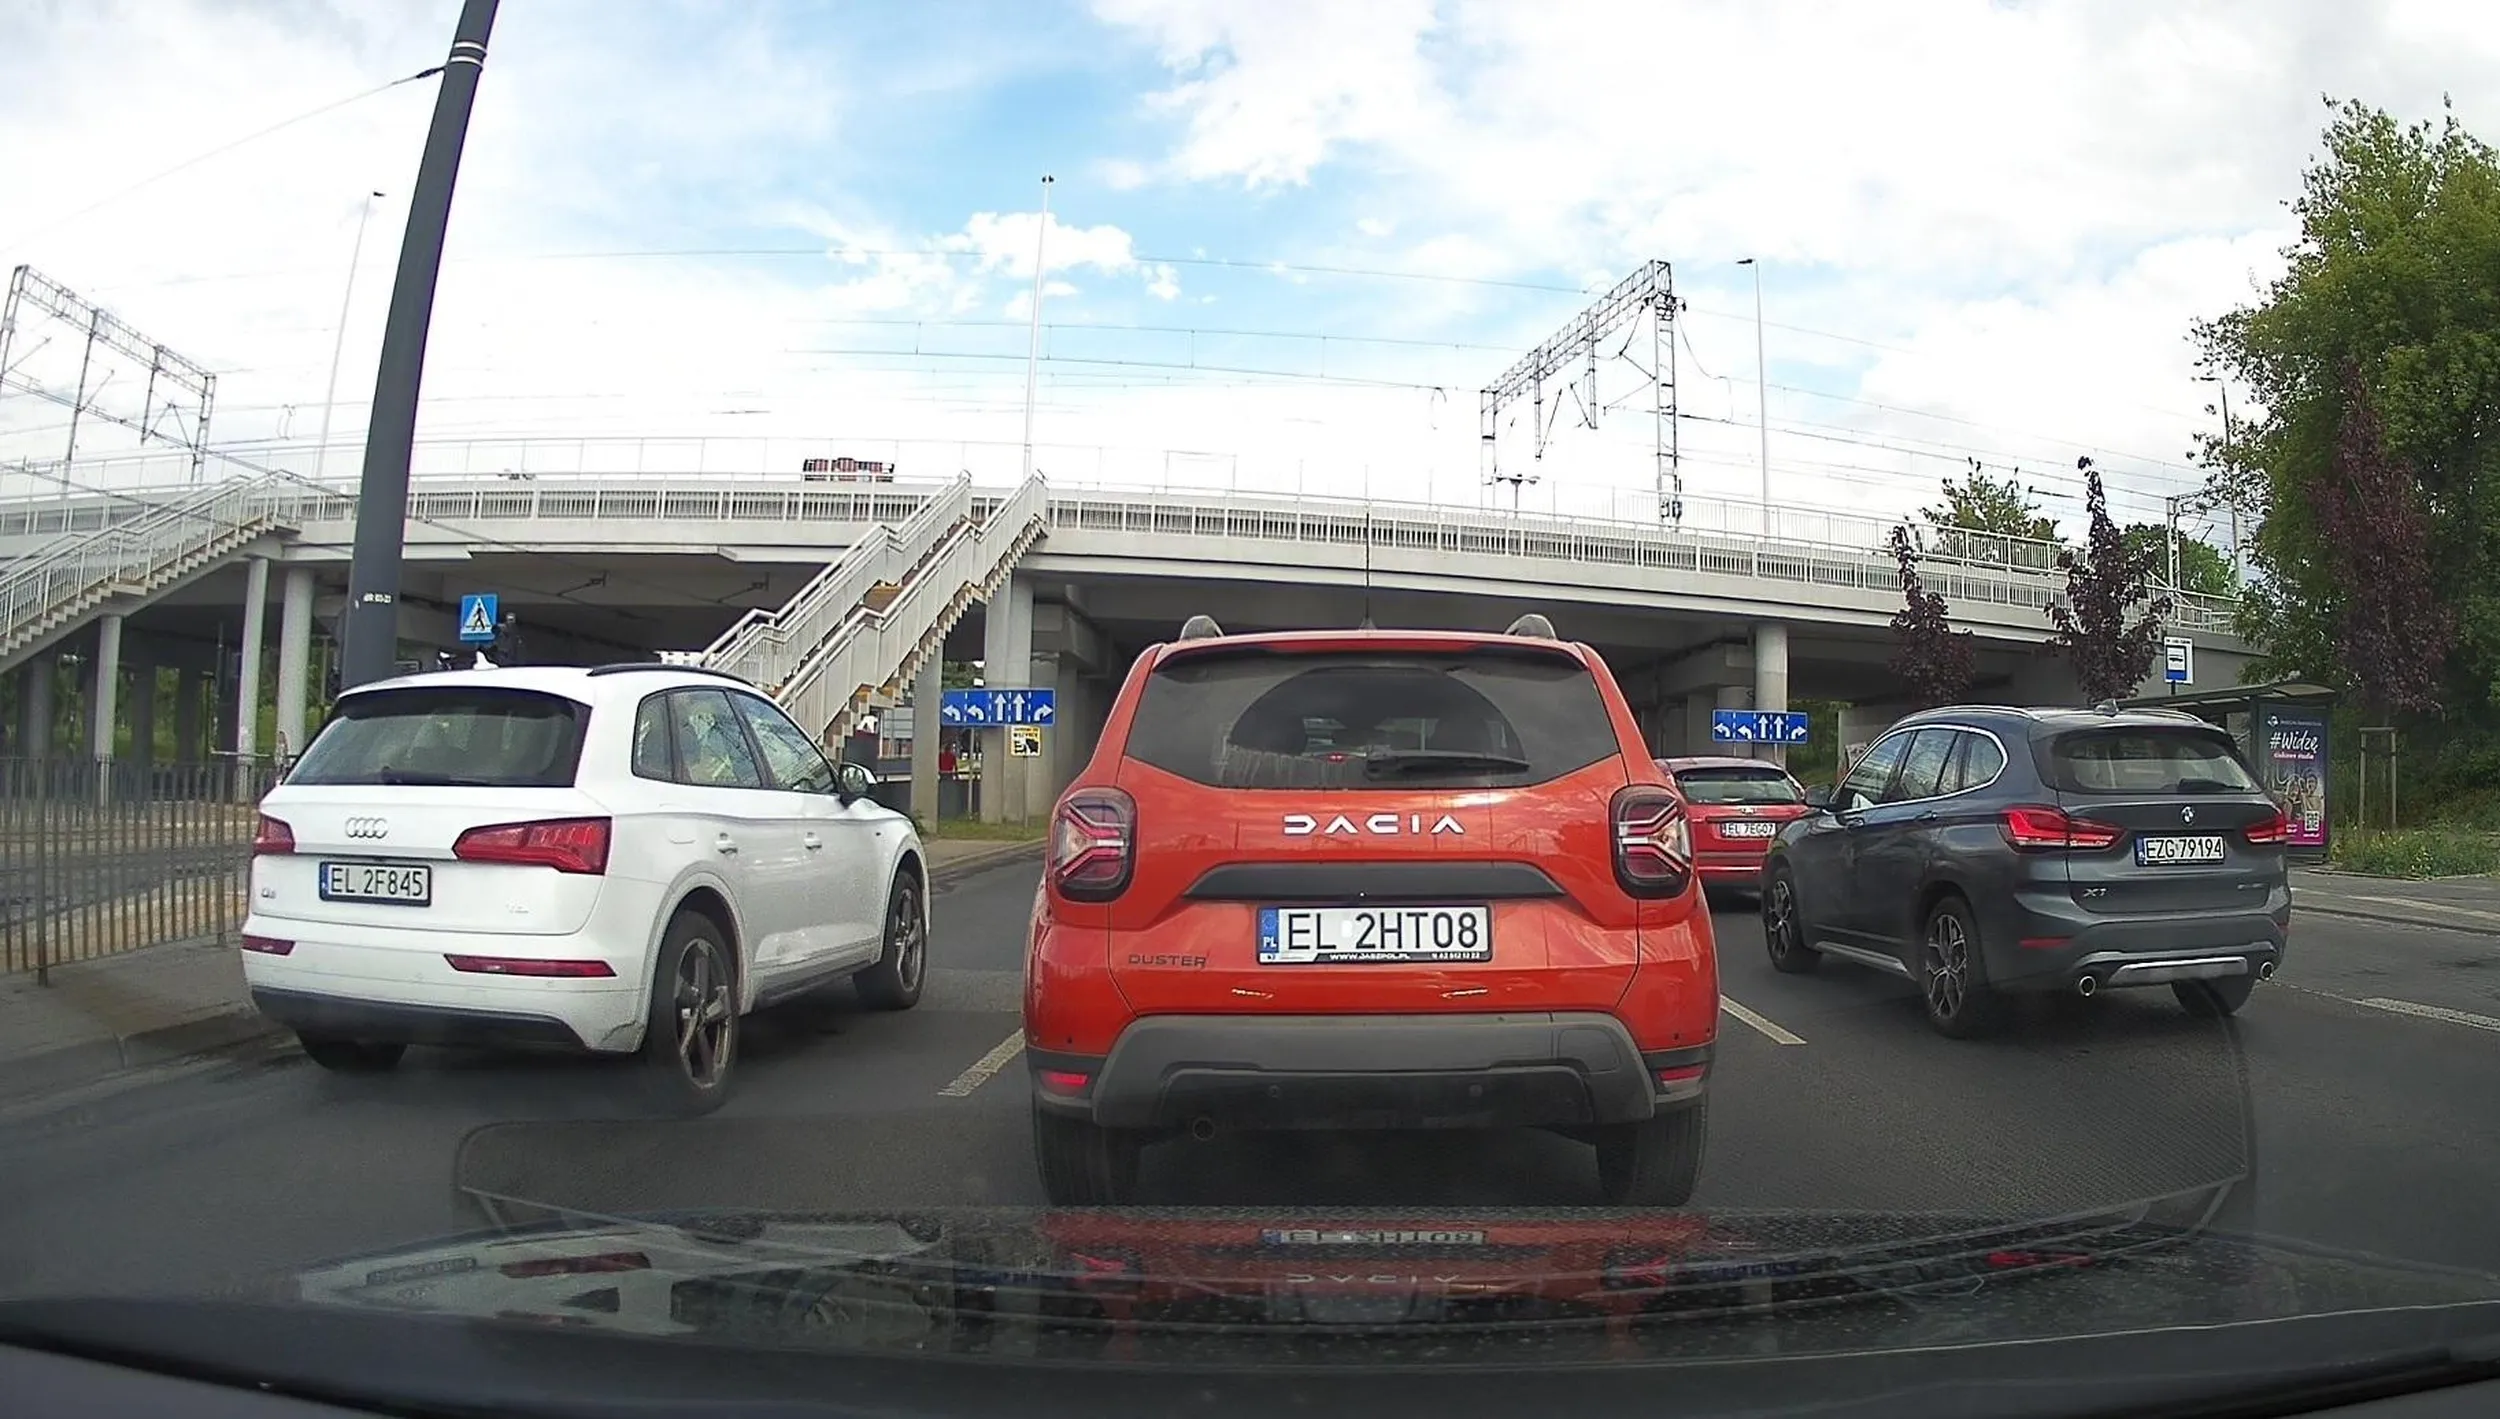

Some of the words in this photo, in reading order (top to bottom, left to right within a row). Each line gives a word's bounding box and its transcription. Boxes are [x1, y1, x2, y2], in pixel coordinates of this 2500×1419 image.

[2269, 730, 2319, 754] #Widzę
[1283, 814, 1465, 834] DACIA
[2146, 839, 2175, 858] EZG
[2179, 838, 2222, 858] 79194
[331, 867, 356, 895] EL
[363, 870, 423, 897] 2F845
[1288, 913, 1337, 950] EL
[1355, 911, 1478, 949] 2HT08
[1263, 936, 1277, 948] PL
[1128, 954, 1207, 967] DUSTER
